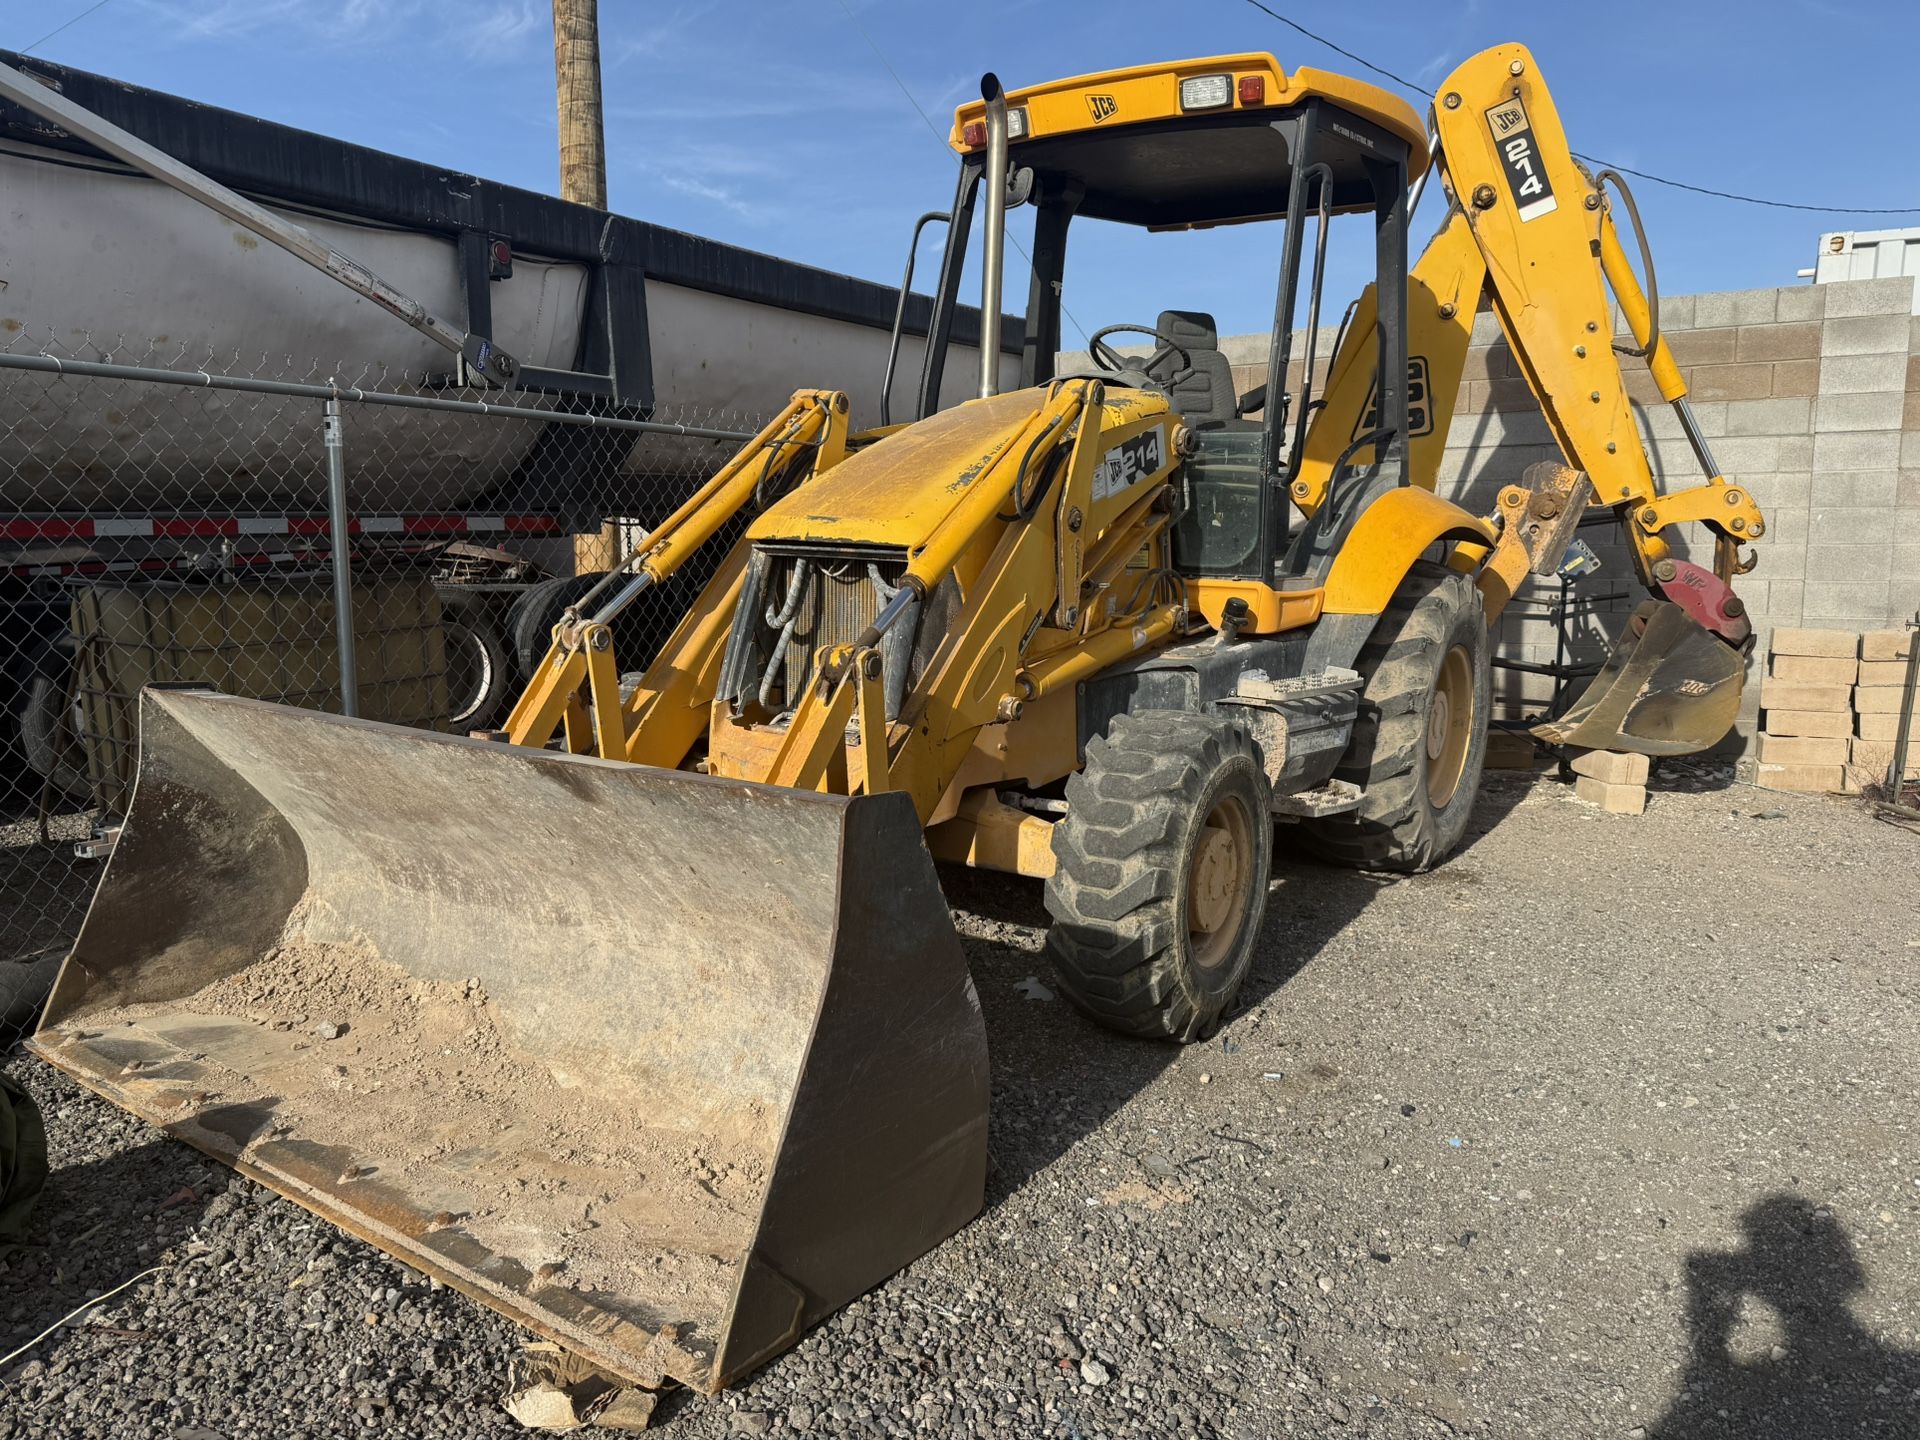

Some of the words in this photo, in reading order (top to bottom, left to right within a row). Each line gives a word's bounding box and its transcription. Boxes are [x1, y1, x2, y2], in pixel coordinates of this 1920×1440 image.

[1090, 96, 1116, 120] JCB
[1496, 110, 1521, 131] JCB
[1505, 137, 1543, 197] 214
[1122, 438, 1158, 477] 214
[1109, 460, 1122, 483] JCB
